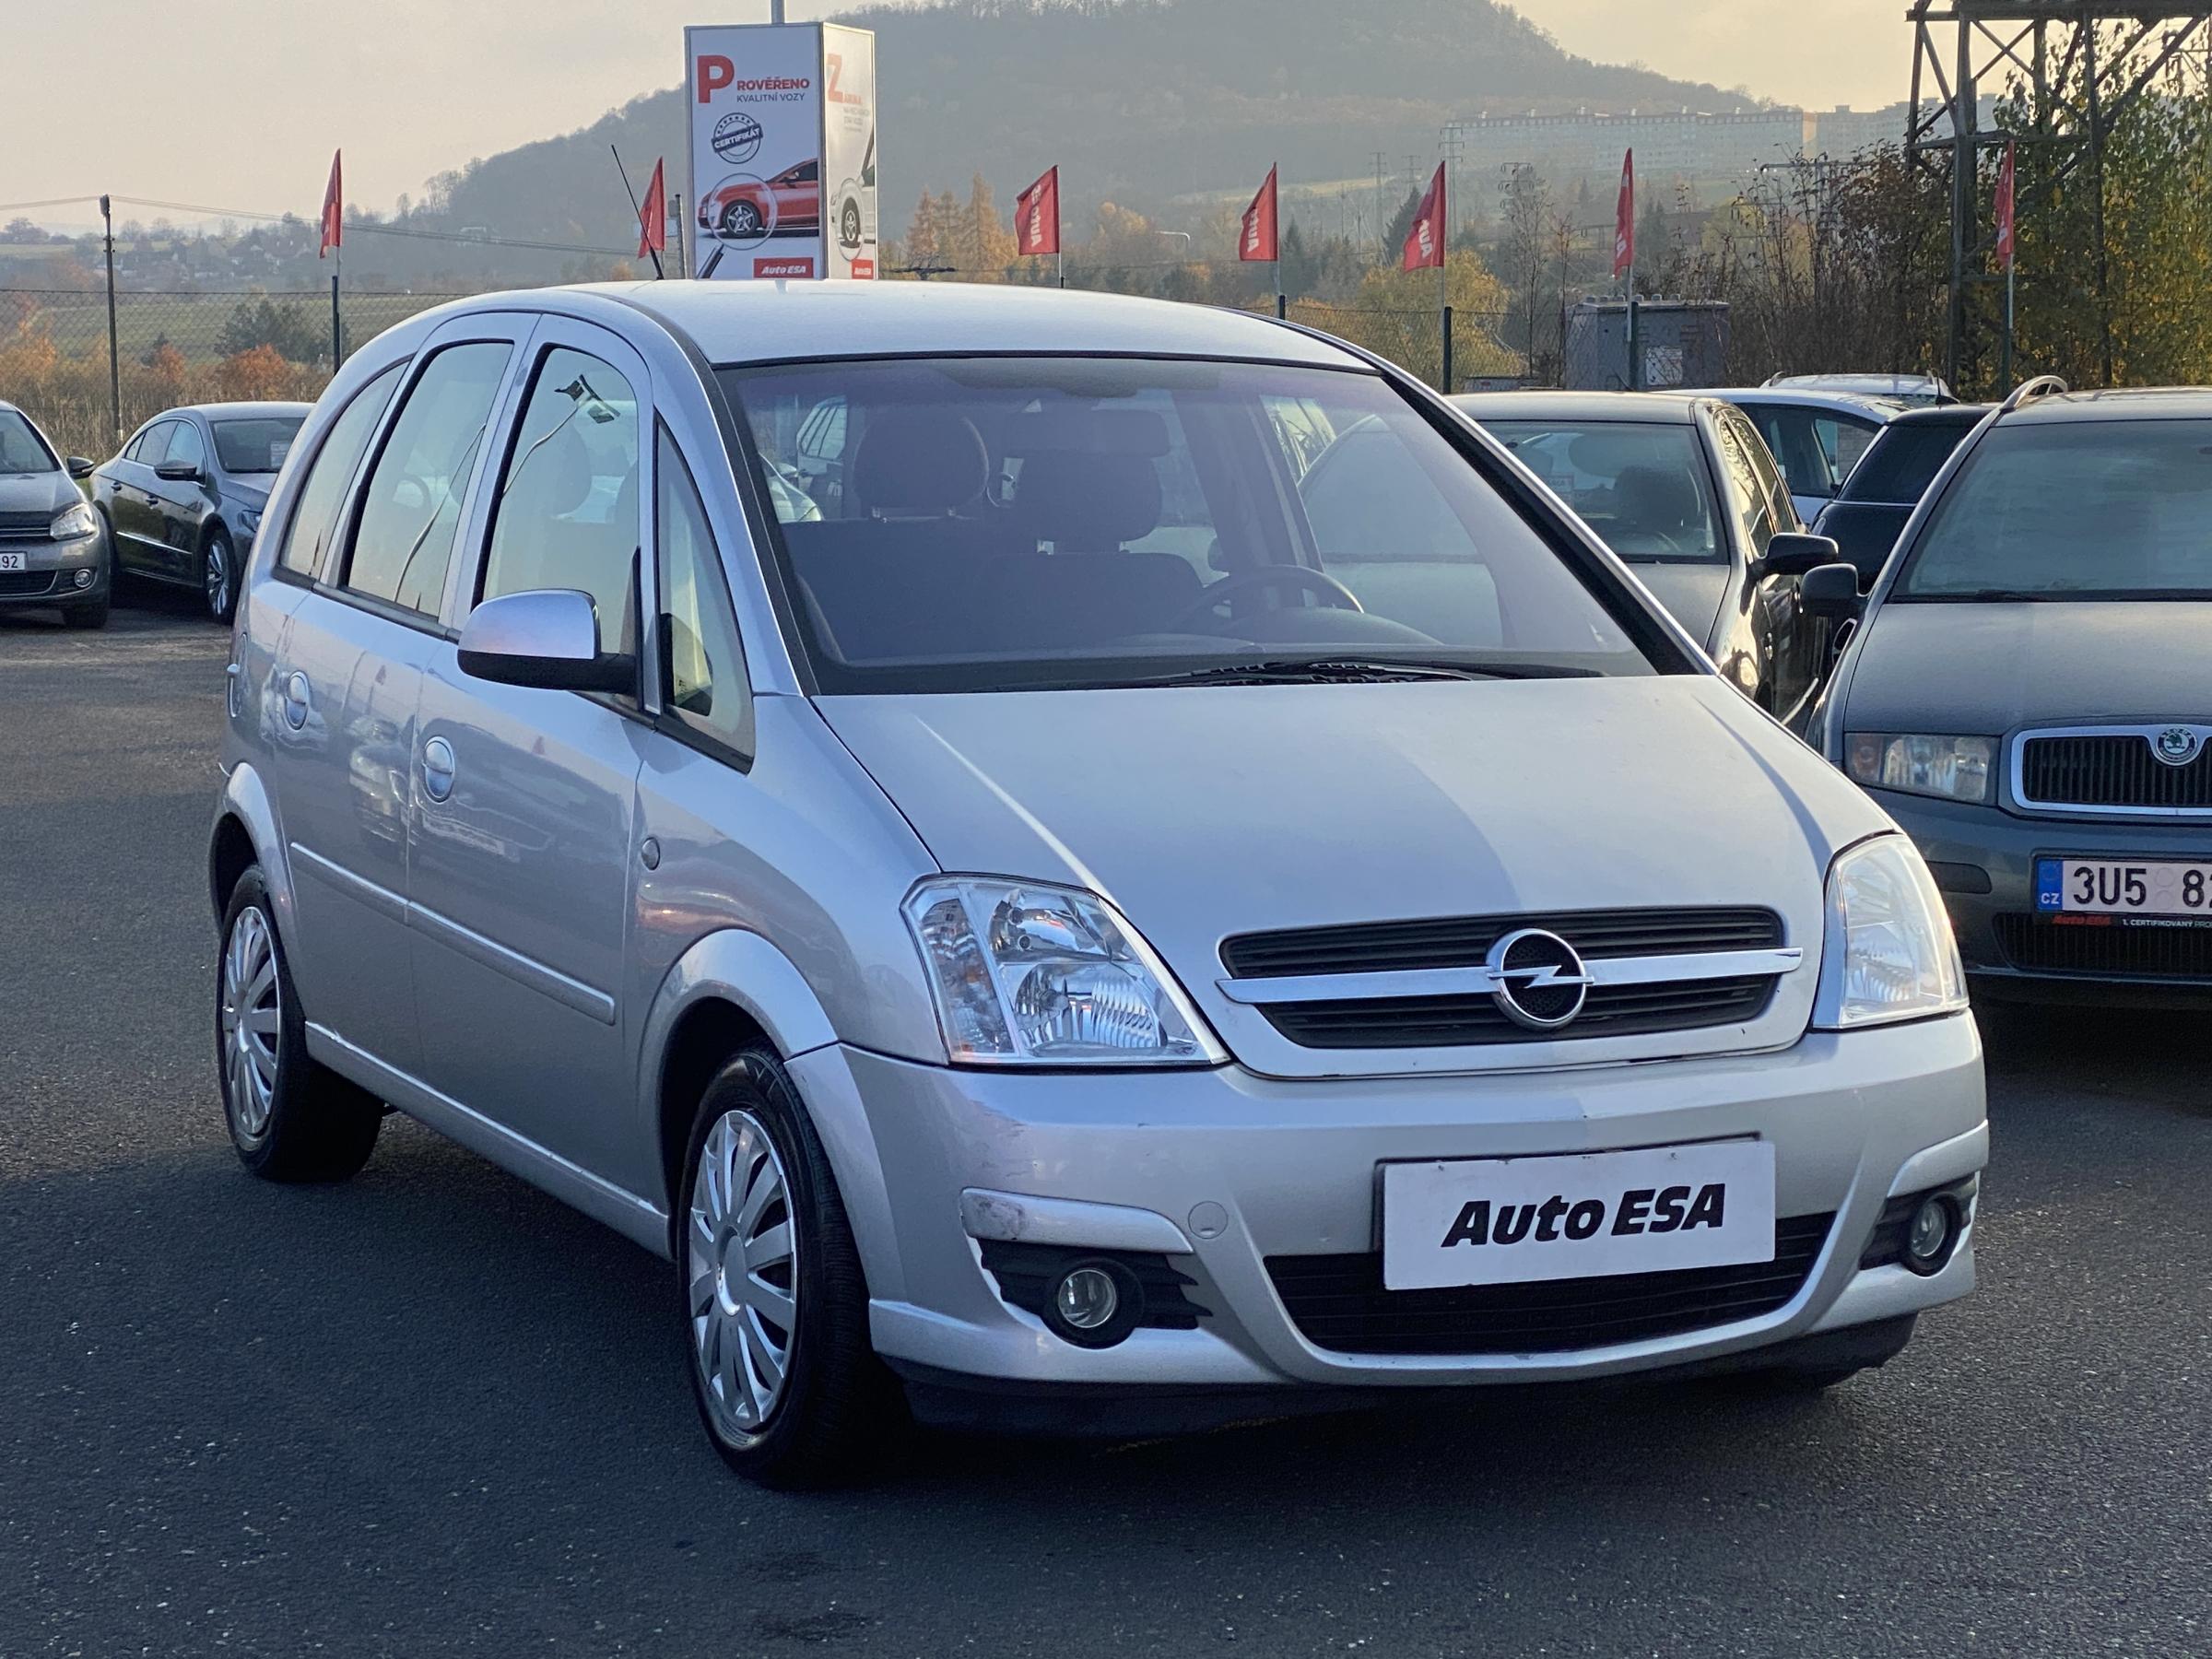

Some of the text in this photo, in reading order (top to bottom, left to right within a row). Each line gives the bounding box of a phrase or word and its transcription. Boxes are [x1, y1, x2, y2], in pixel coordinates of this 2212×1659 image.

[737, 93, 805, 103] KVALITNÍ VOZY
[761, 265, 806, 275] Auto ESA
[2074, 866, 2212, 908] 3U5 8
[2041, 893, 2059, 904] CZ
[1441, 1183, 1725, 1247] Auto ESA
